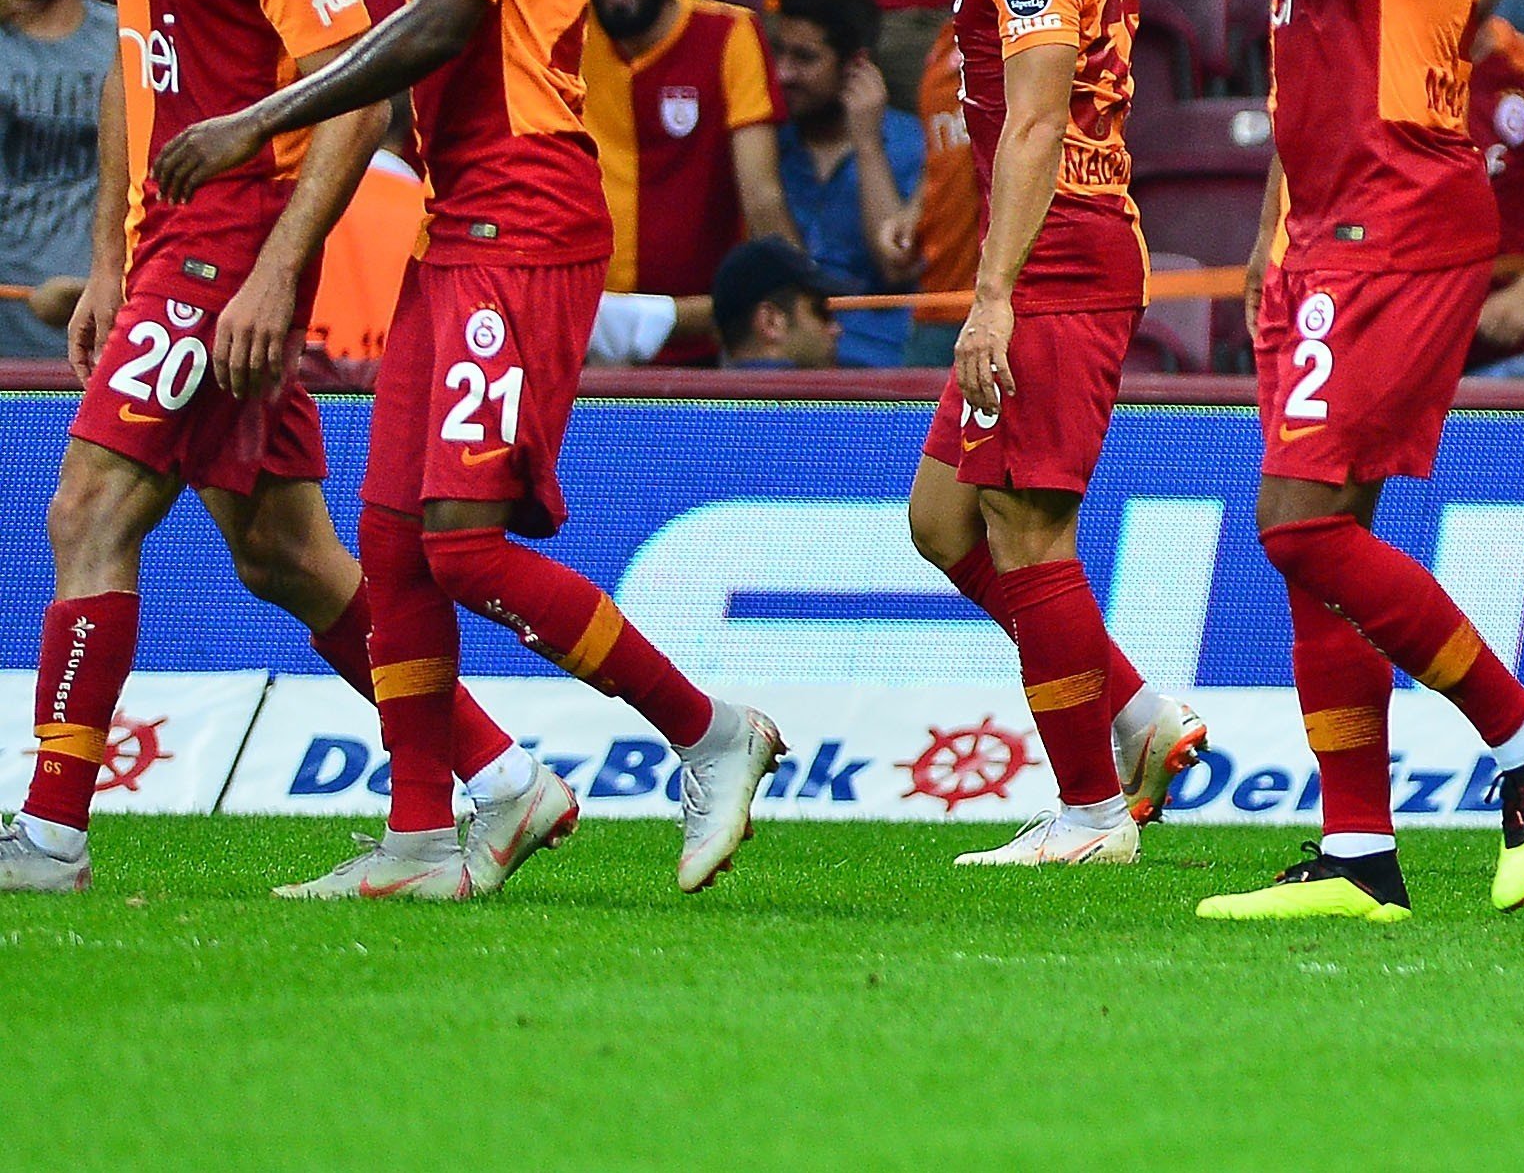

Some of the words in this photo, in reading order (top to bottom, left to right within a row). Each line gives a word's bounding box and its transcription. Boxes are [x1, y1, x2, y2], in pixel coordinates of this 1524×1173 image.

[107, 320, 208, 411] 20
[440, 360, 525, 445] 21
[1283, 339, 1334, 420] 2
[43, 759, 63, 776] GS
